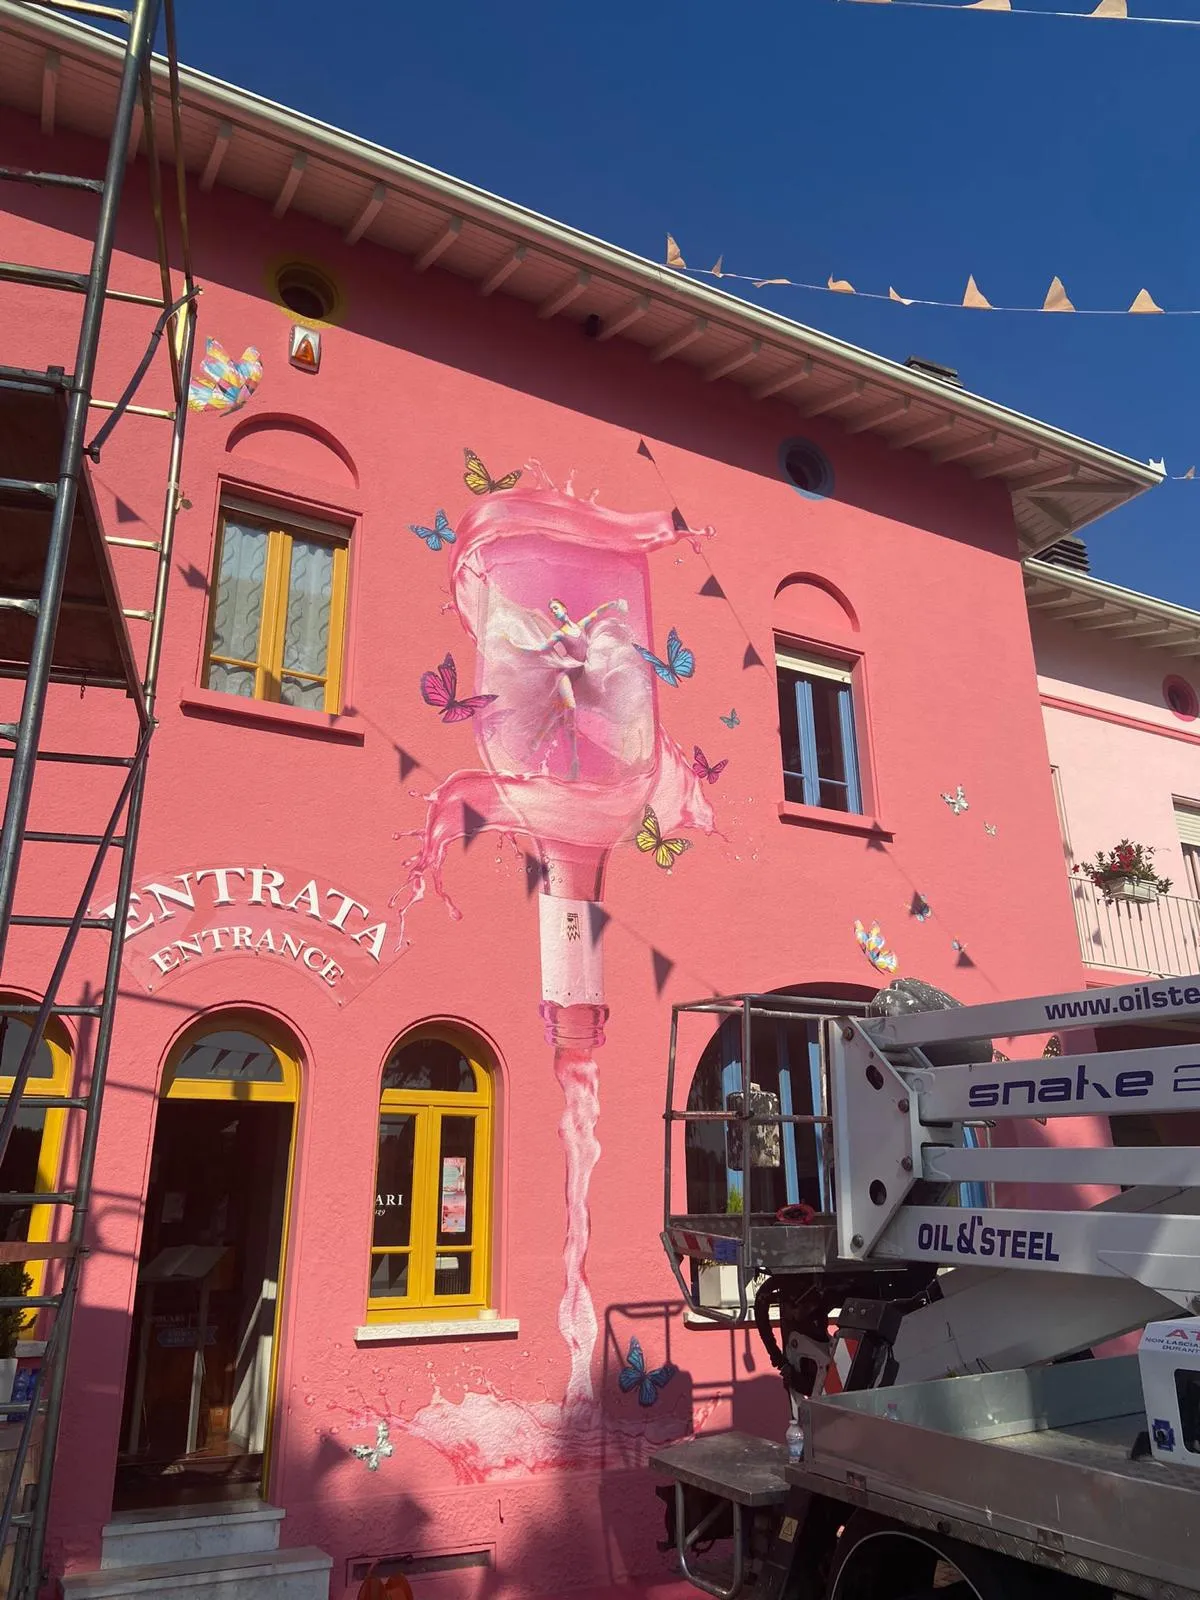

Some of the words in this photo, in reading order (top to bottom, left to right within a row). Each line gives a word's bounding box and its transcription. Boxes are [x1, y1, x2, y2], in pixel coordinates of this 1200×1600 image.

[99, 867, 388, 962] ENTRATA
[149, 926, 345, 986] ENTRANCE
[1045, 986, 1200, 1020] www.oilste
[968, 1064, 1154, 1108] snake
[1166, 1340, 1200, 1348] LASCIA
